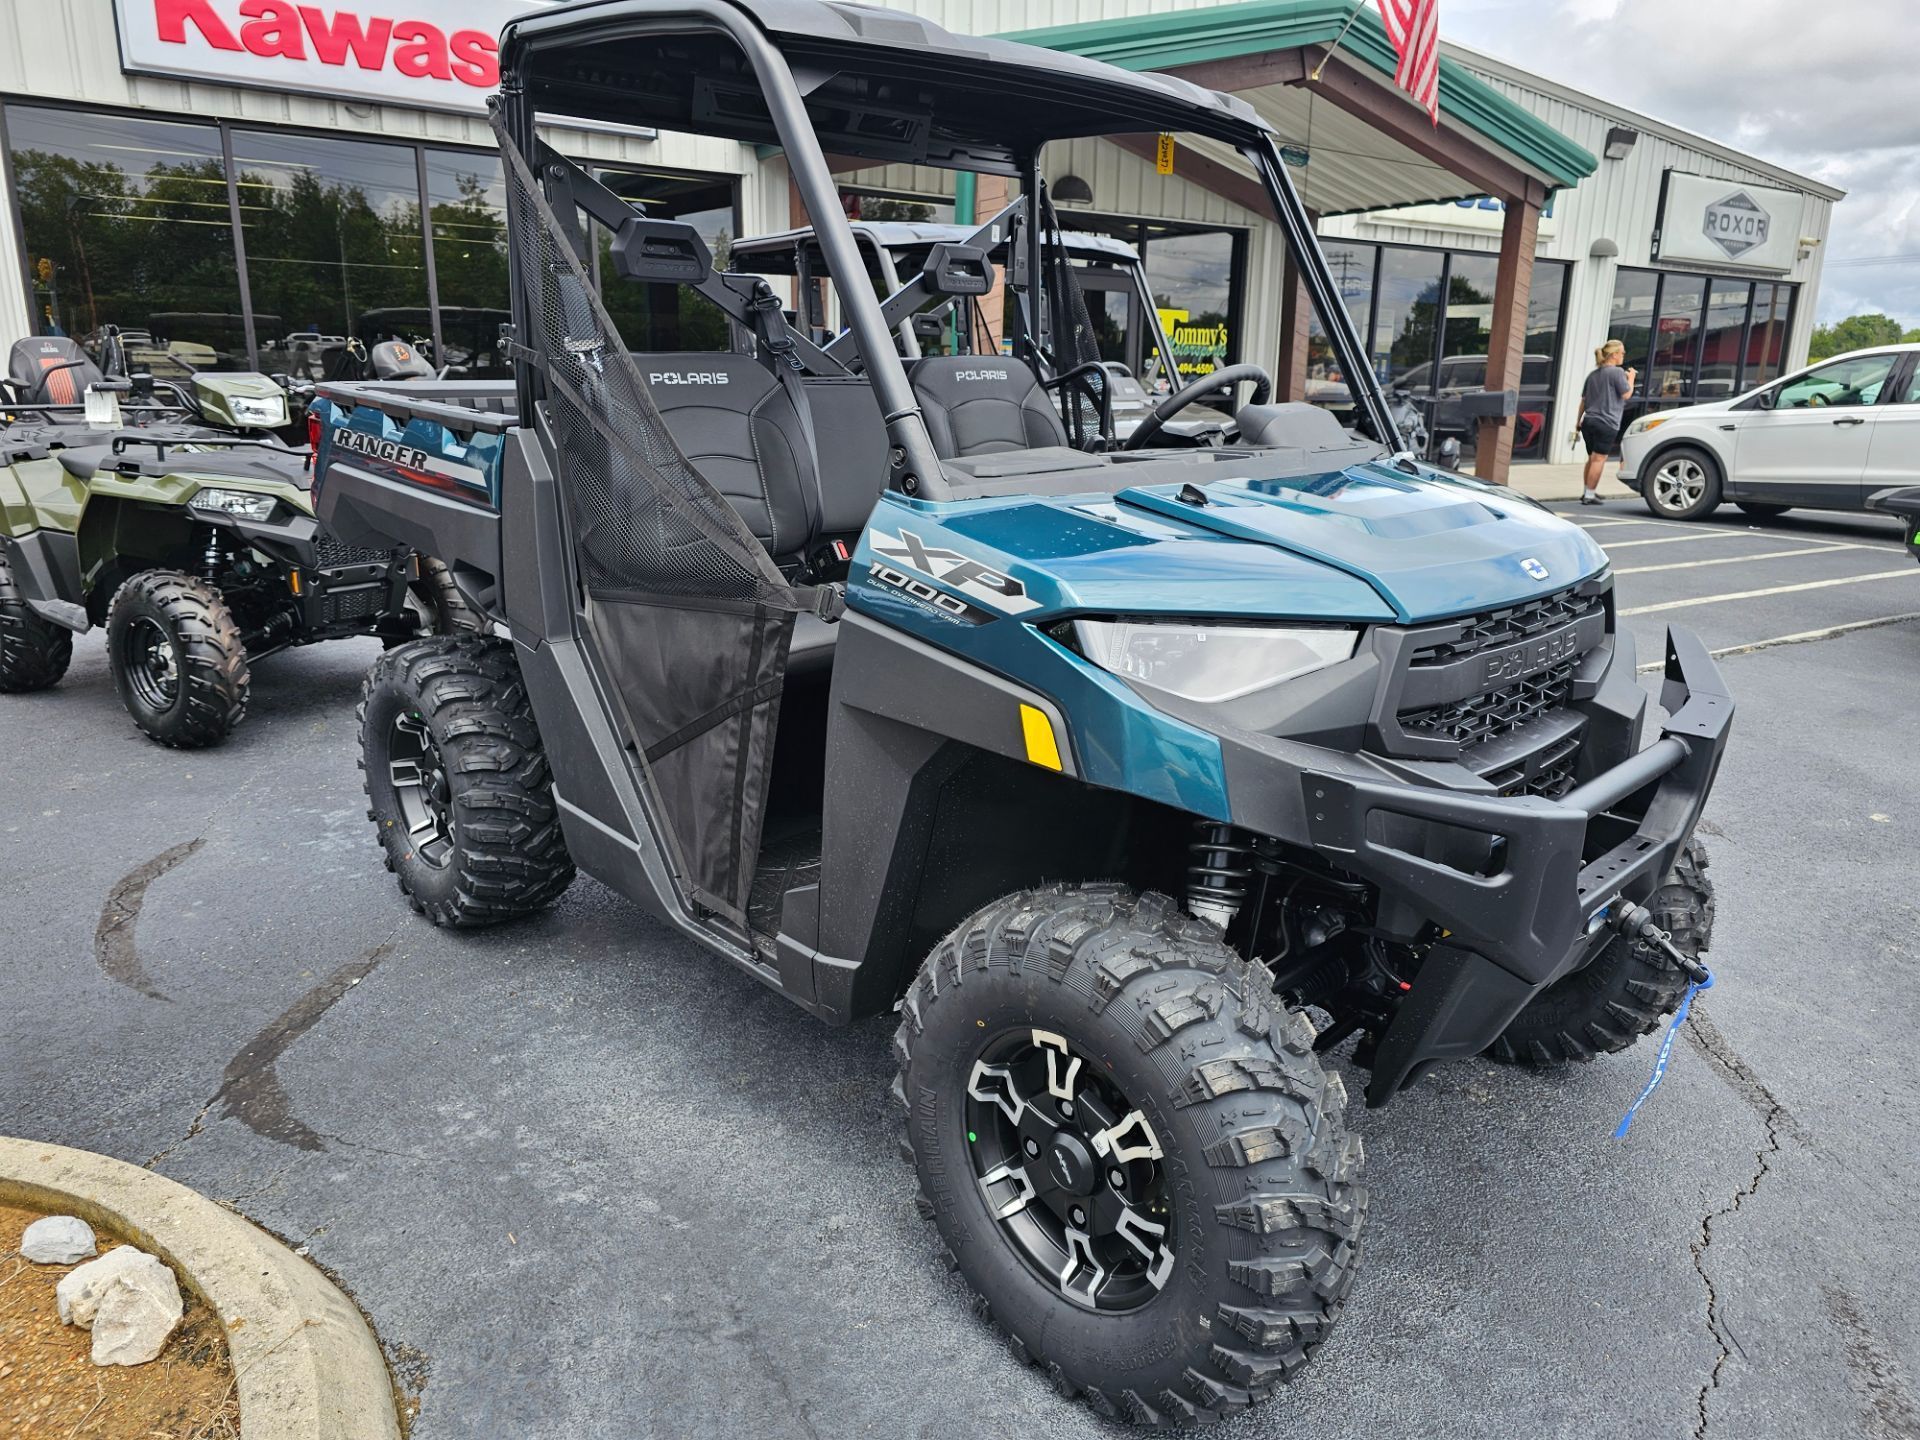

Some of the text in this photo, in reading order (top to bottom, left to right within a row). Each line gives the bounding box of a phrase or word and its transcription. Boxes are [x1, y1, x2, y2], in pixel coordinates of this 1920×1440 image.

[154, 0, 500, 88] Kawas
[1706, 211, 1766, 238] ROXOR
[1152, 308, 1228, 356] Tommy's
[649, 372, 729, 386] POLARIS
[955, 370, 1008, 382] POLARIS
[335, 427, 428, 472] RANGER
[868, 562, 968, 615] 1000
[870, 527, 1031, 603] XP
[866, 578, 961, 625] DUAL OVERHEAD CAM
[1483, 627, 1578, 686] POLARIS
